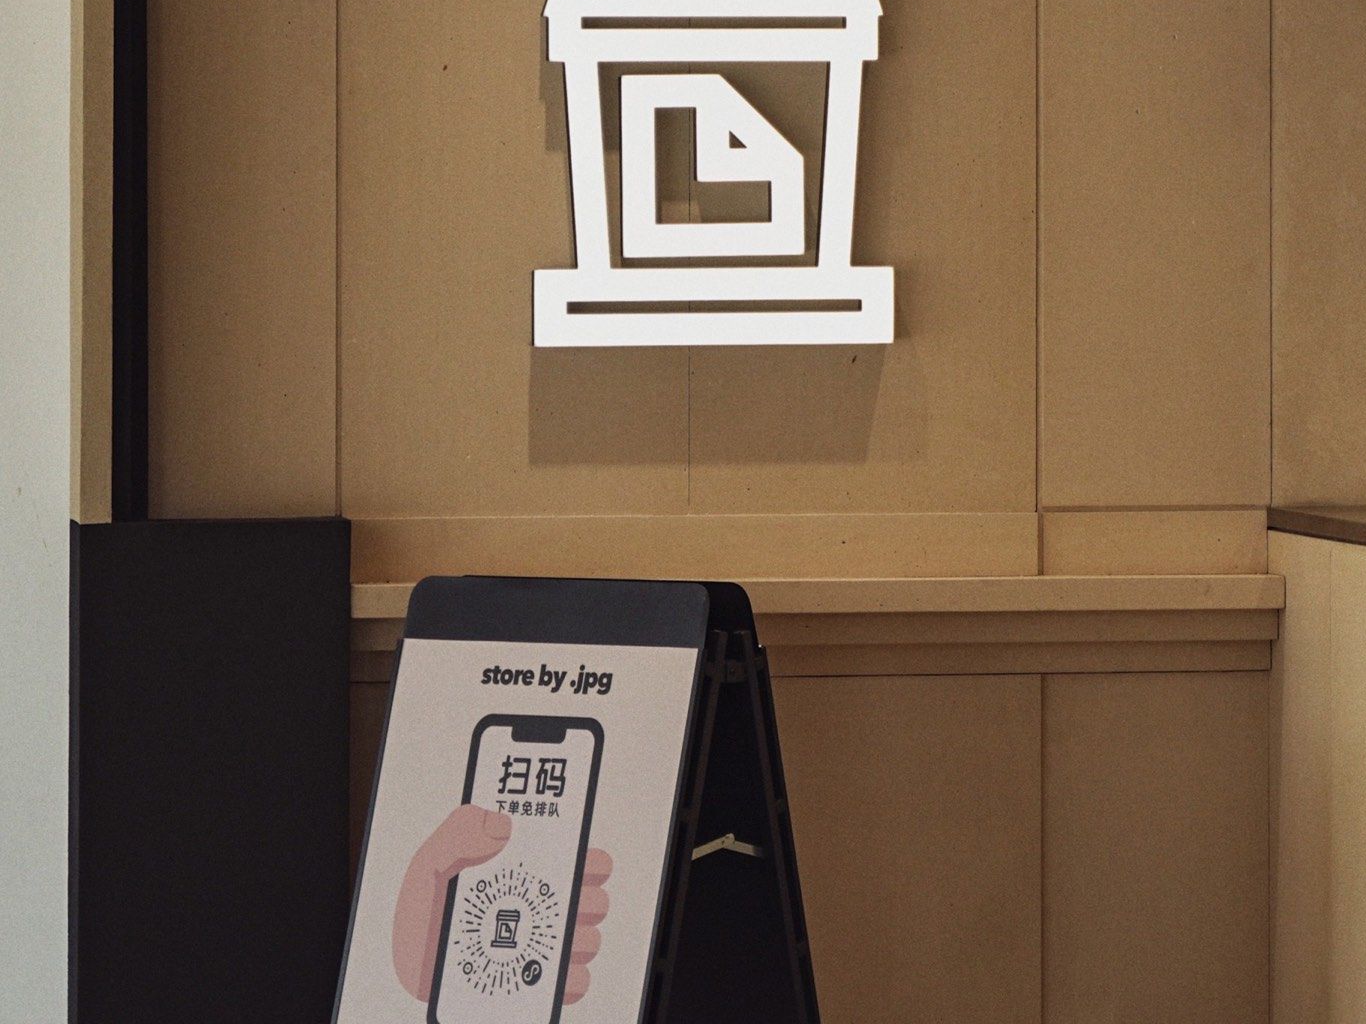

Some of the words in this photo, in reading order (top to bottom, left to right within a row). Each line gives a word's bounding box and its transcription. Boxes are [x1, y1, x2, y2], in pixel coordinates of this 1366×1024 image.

[481, 665, 535, 686] store
[538, 663, 567, 693] by
[570, 664, 613, 695] .jpg
[497, 754, 567, 798] 扫码
[496, 800, 560, 818] 下单免排队
